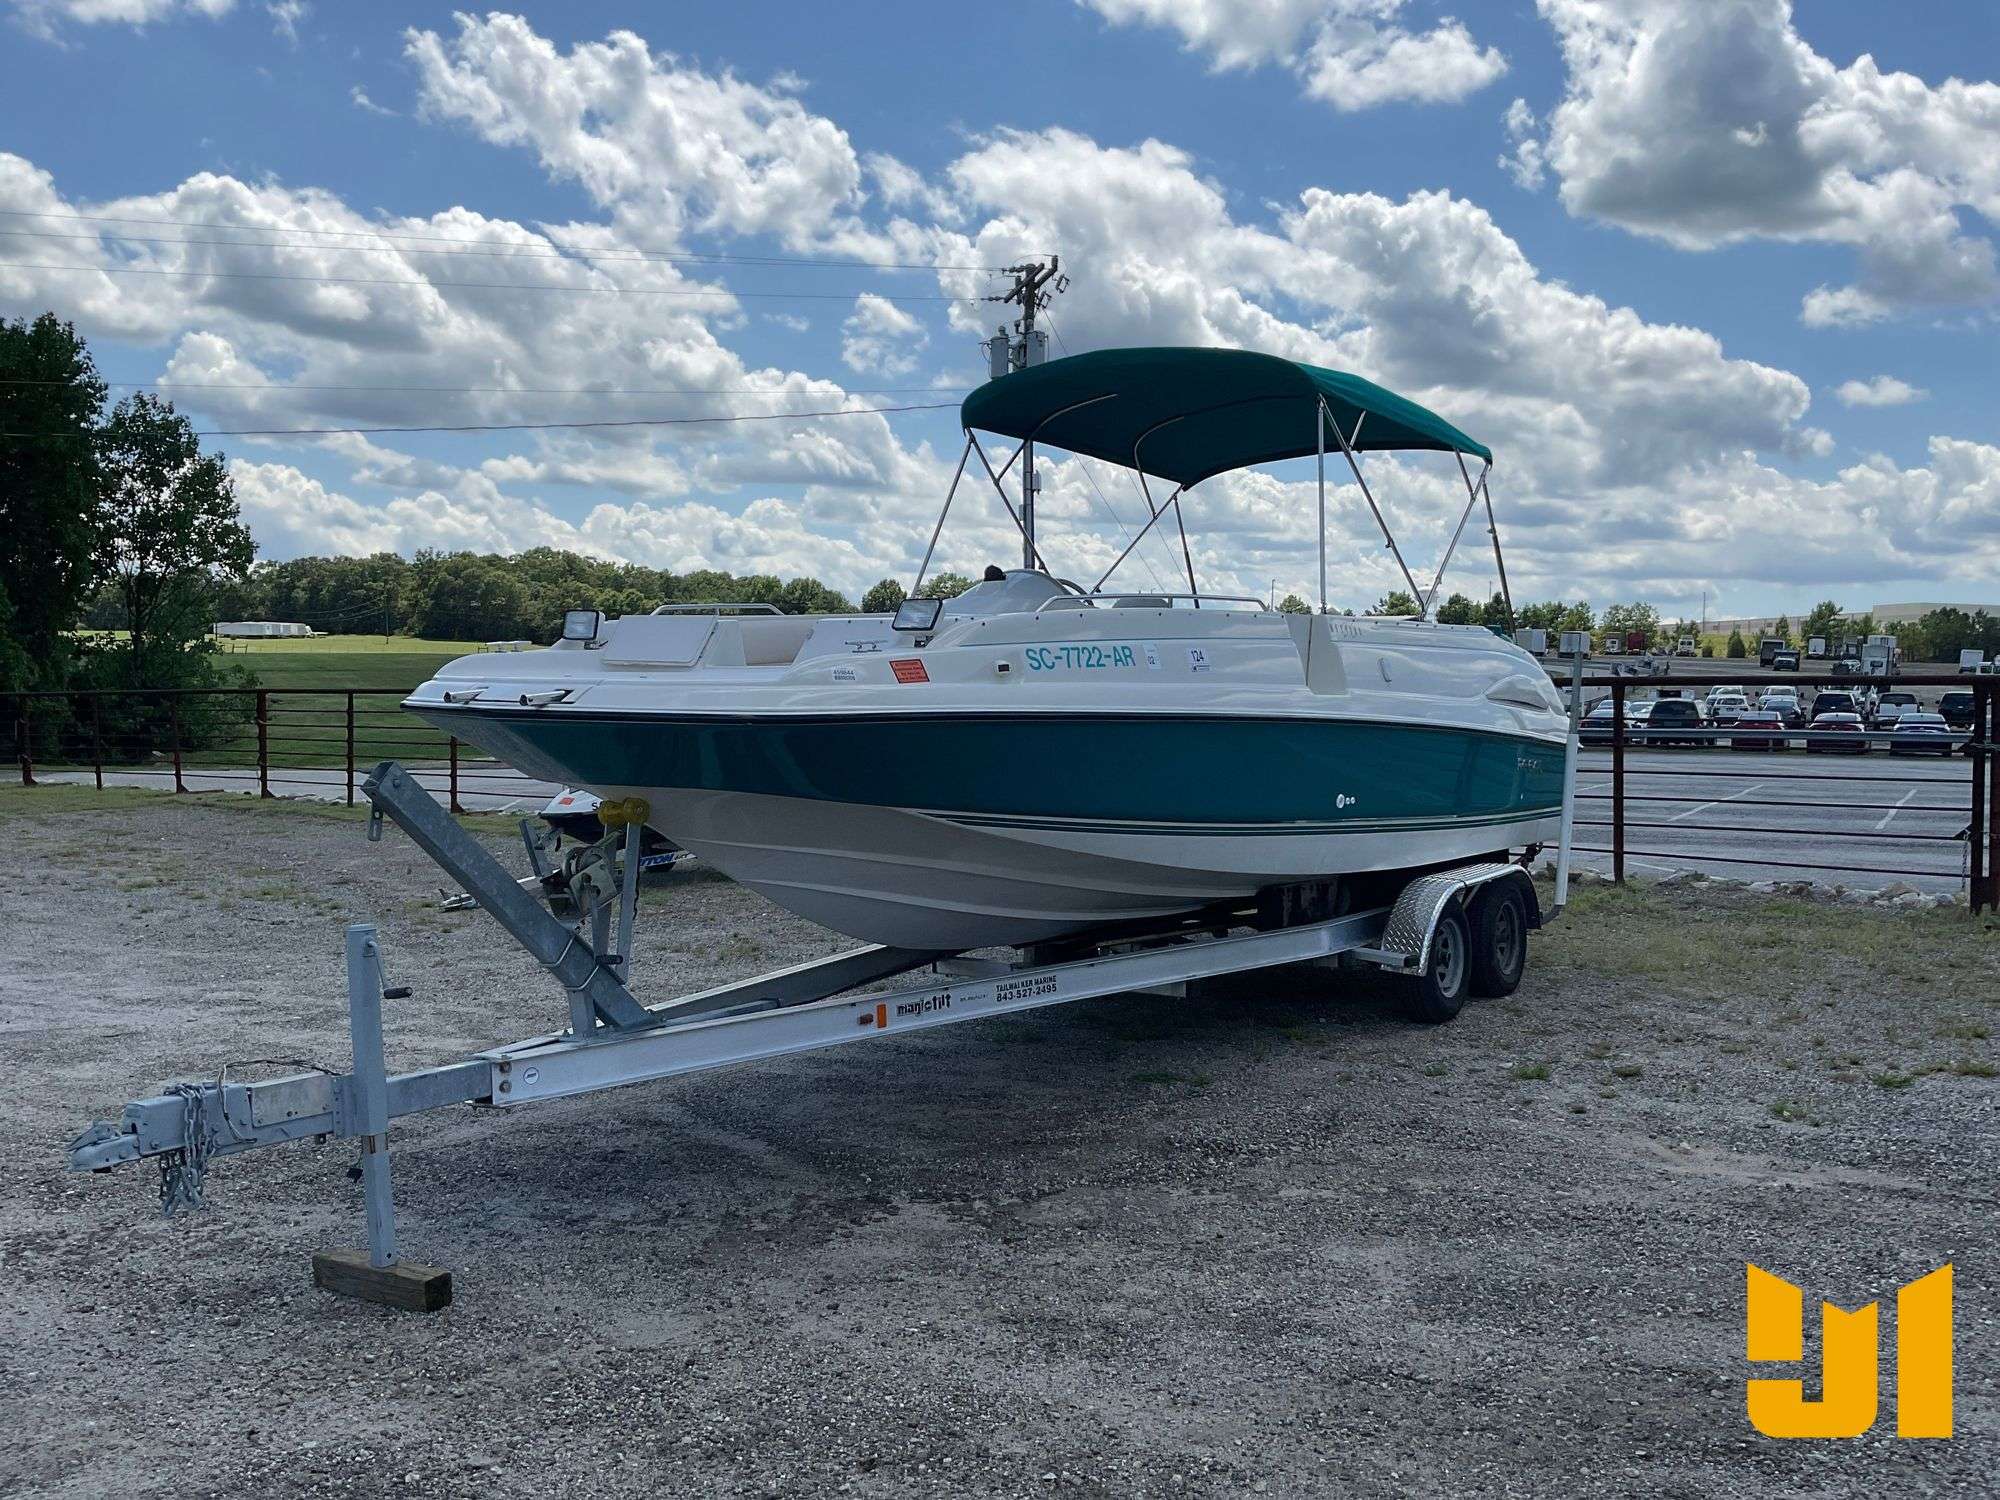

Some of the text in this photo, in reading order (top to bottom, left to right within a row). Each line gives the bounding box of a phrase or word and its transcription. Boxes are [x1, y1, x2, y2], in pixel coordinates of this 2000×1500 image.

[1025, 645, 1136, 671] SC-7722-AR
[1034, 975, 1057, 986] MARINE
[997, 983, 1057, 1002] 843-527-2495
